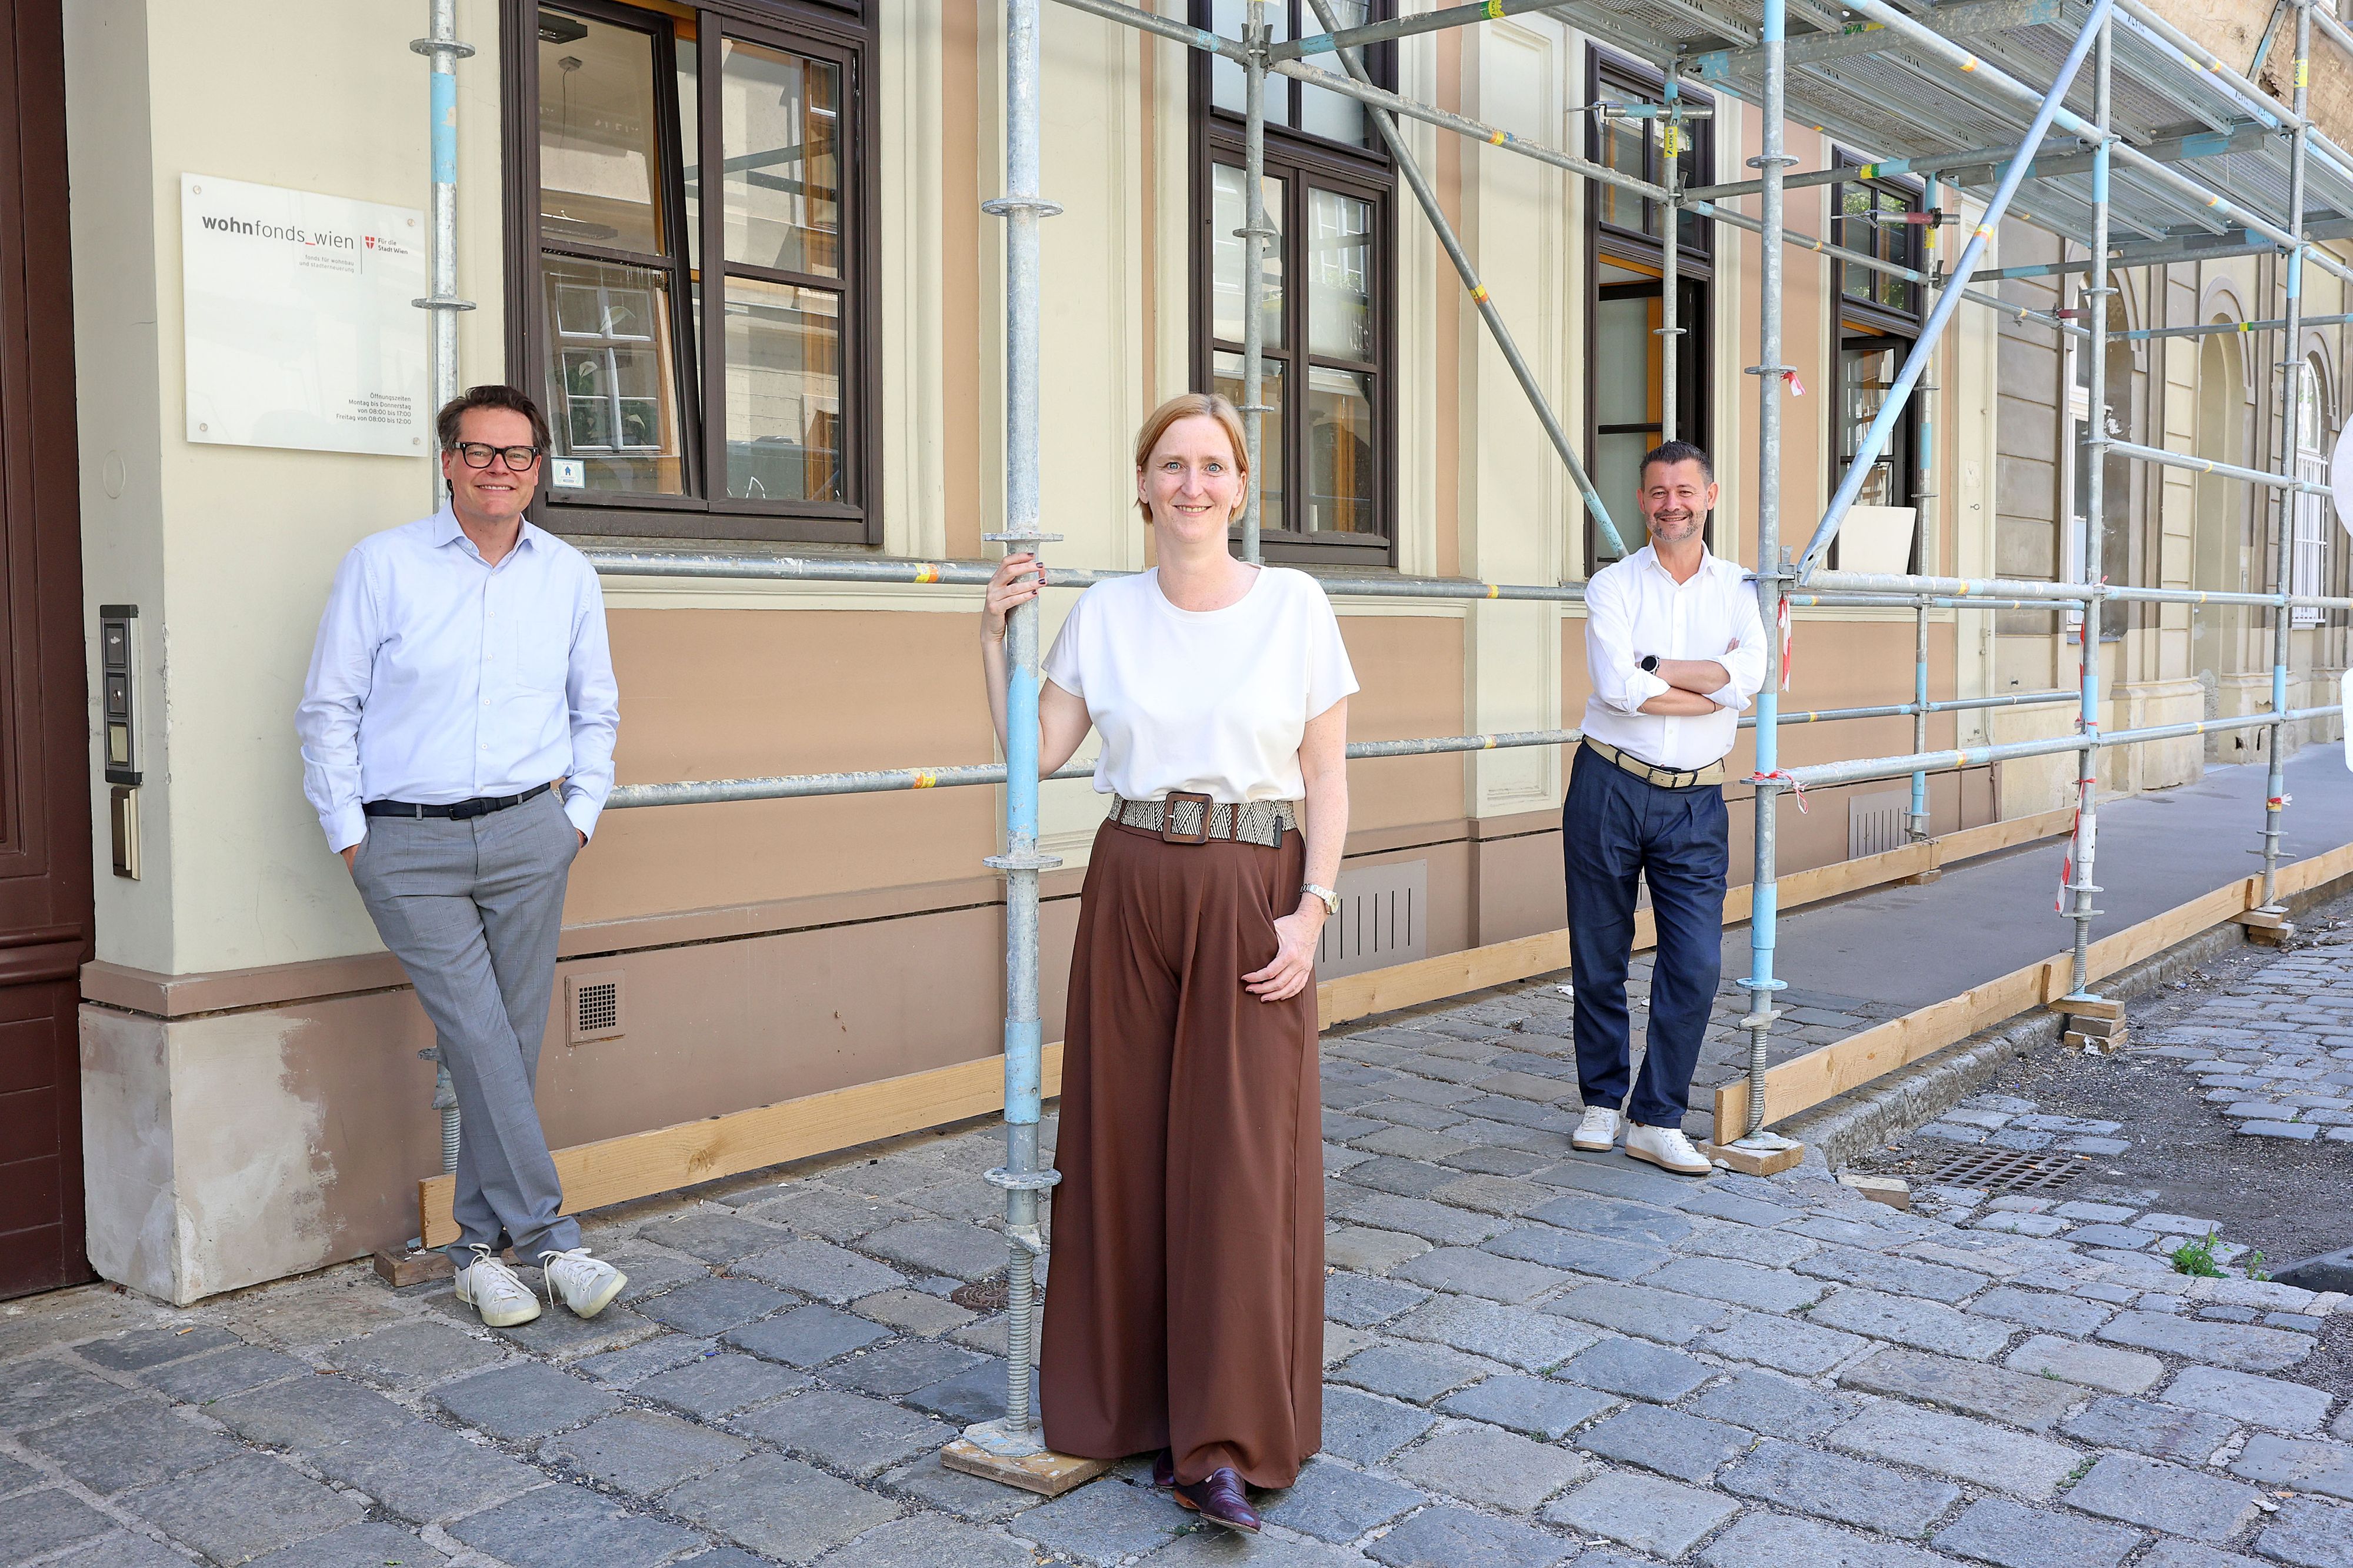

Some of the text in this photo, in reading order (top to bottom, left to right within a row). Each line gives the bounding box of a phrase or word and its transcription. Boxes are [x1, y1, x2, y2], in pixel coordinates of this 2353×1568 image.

[202, 216, 354, 249] wohnfonds_wien
[311, 262, 354, 273] stadterneuerung
[370, 392, 411, 402] Öffnungszeiten
[348, 399, 369, 407] Montag
[380, 402, 411, 410] Donnerstag
